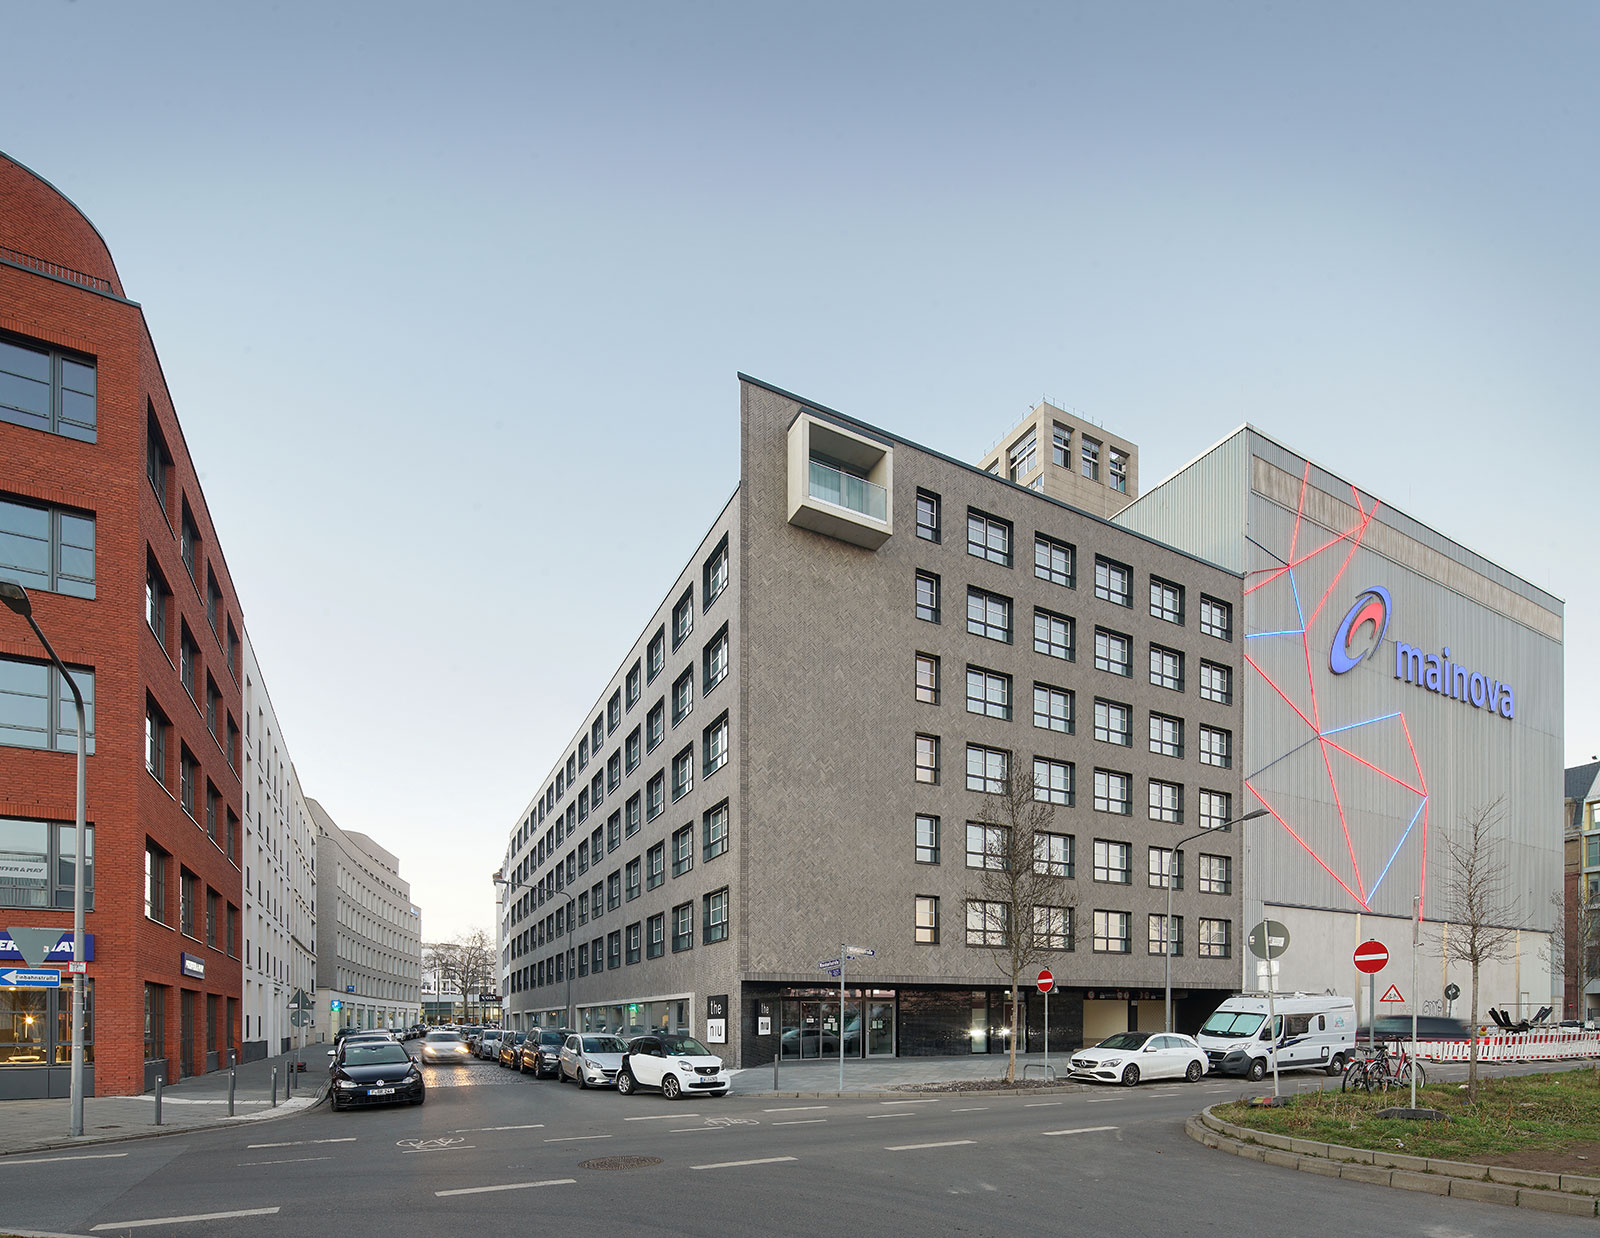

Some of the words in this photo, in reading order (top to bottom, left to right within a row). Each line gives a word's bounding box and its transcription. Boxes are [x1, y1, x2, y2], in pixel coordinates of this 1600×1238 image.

[1394, 641, 1514, 720] mainova
[710, 1000, 722, 1015] the
[710, 1025, 722, 1037] niu
